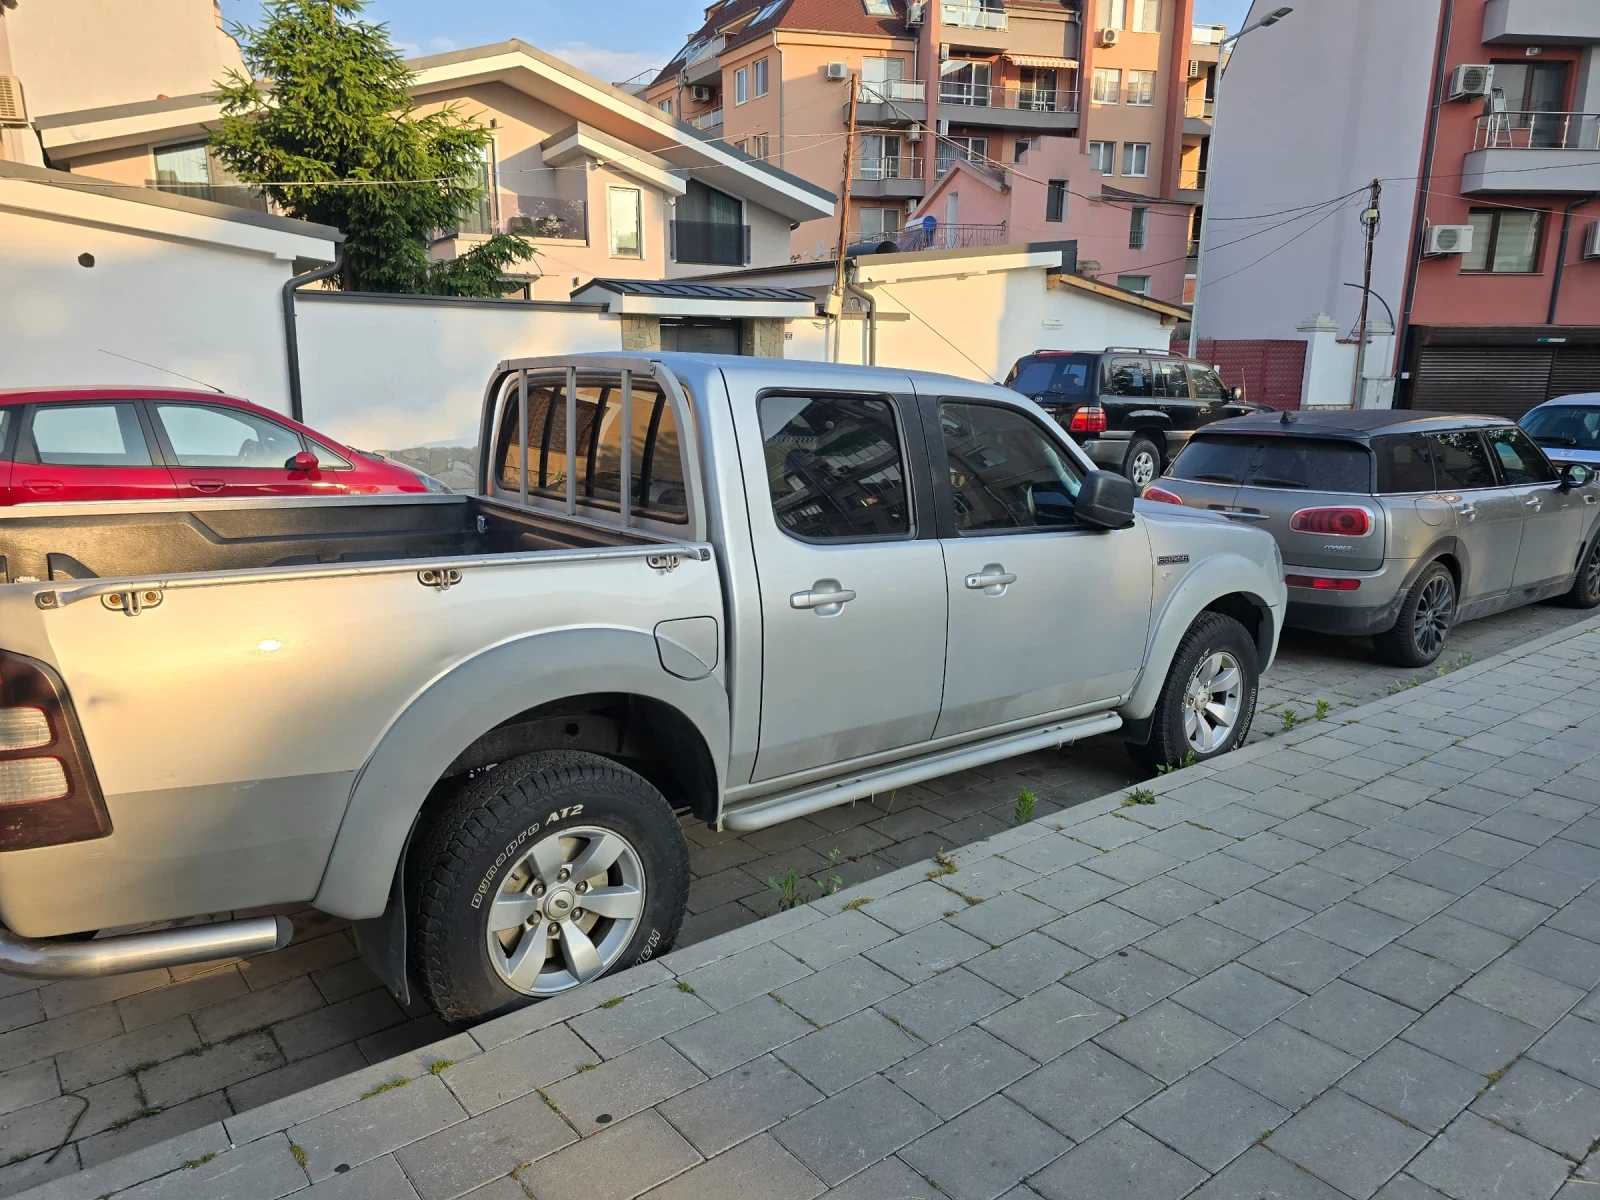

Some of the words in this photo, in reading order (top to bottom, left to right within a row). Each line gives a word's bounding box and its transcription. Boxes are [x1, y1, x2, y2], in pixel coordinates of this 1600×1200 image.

[1157, 554, 1190, 566] RANGER
[471, 822, 540, 909] Dynapro
[545, 804, 584, 826] AT2
